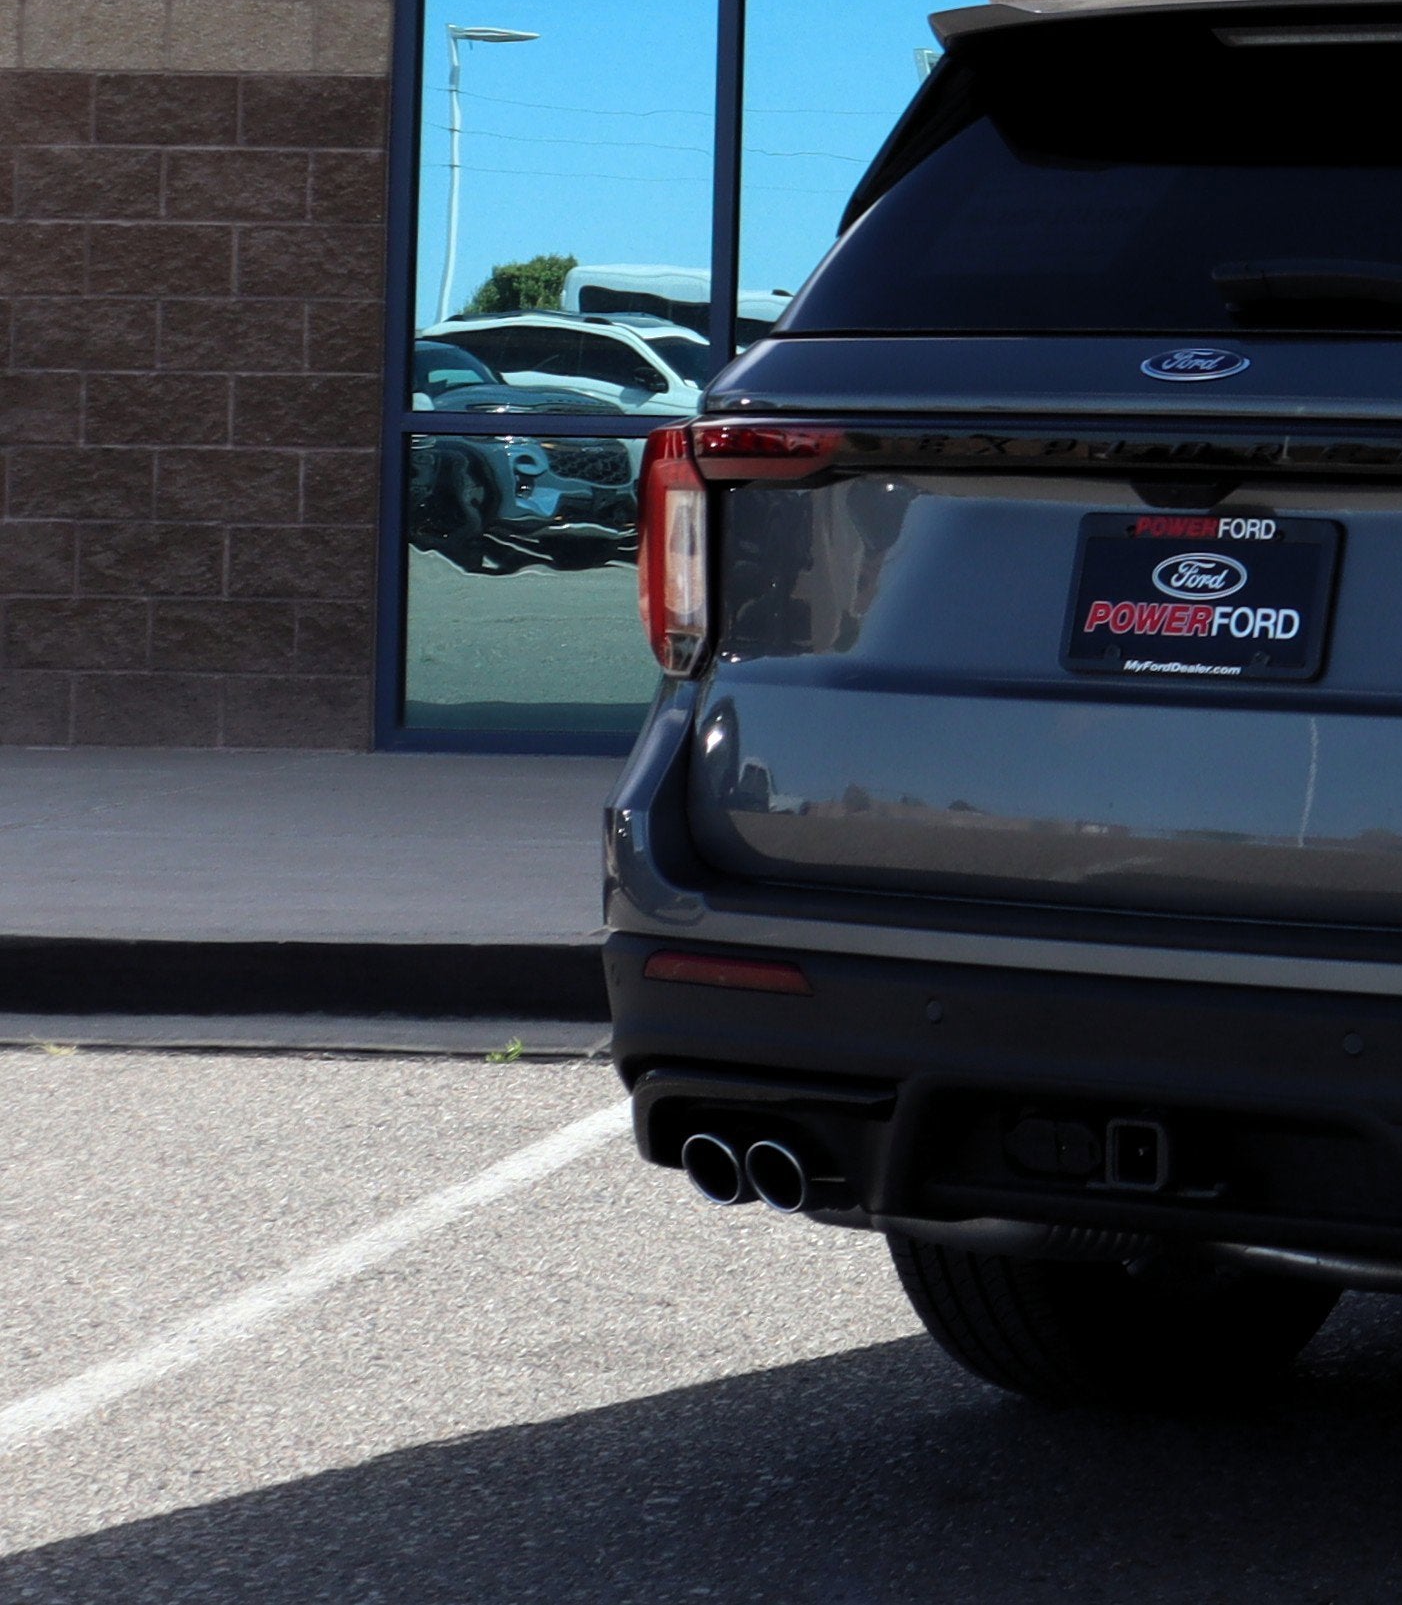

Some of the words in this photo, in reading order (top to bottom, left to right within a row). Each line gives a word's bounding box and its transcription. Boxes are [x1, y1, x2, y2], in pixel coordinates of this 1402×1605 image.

[1162, 349, 1221, 371] Ford
[1170, 561, 1228, 591] Ford
[1085, 601, 1300, 640] POWERFORD
[1123, 659, 1242, 676] MyFordDealer.com
